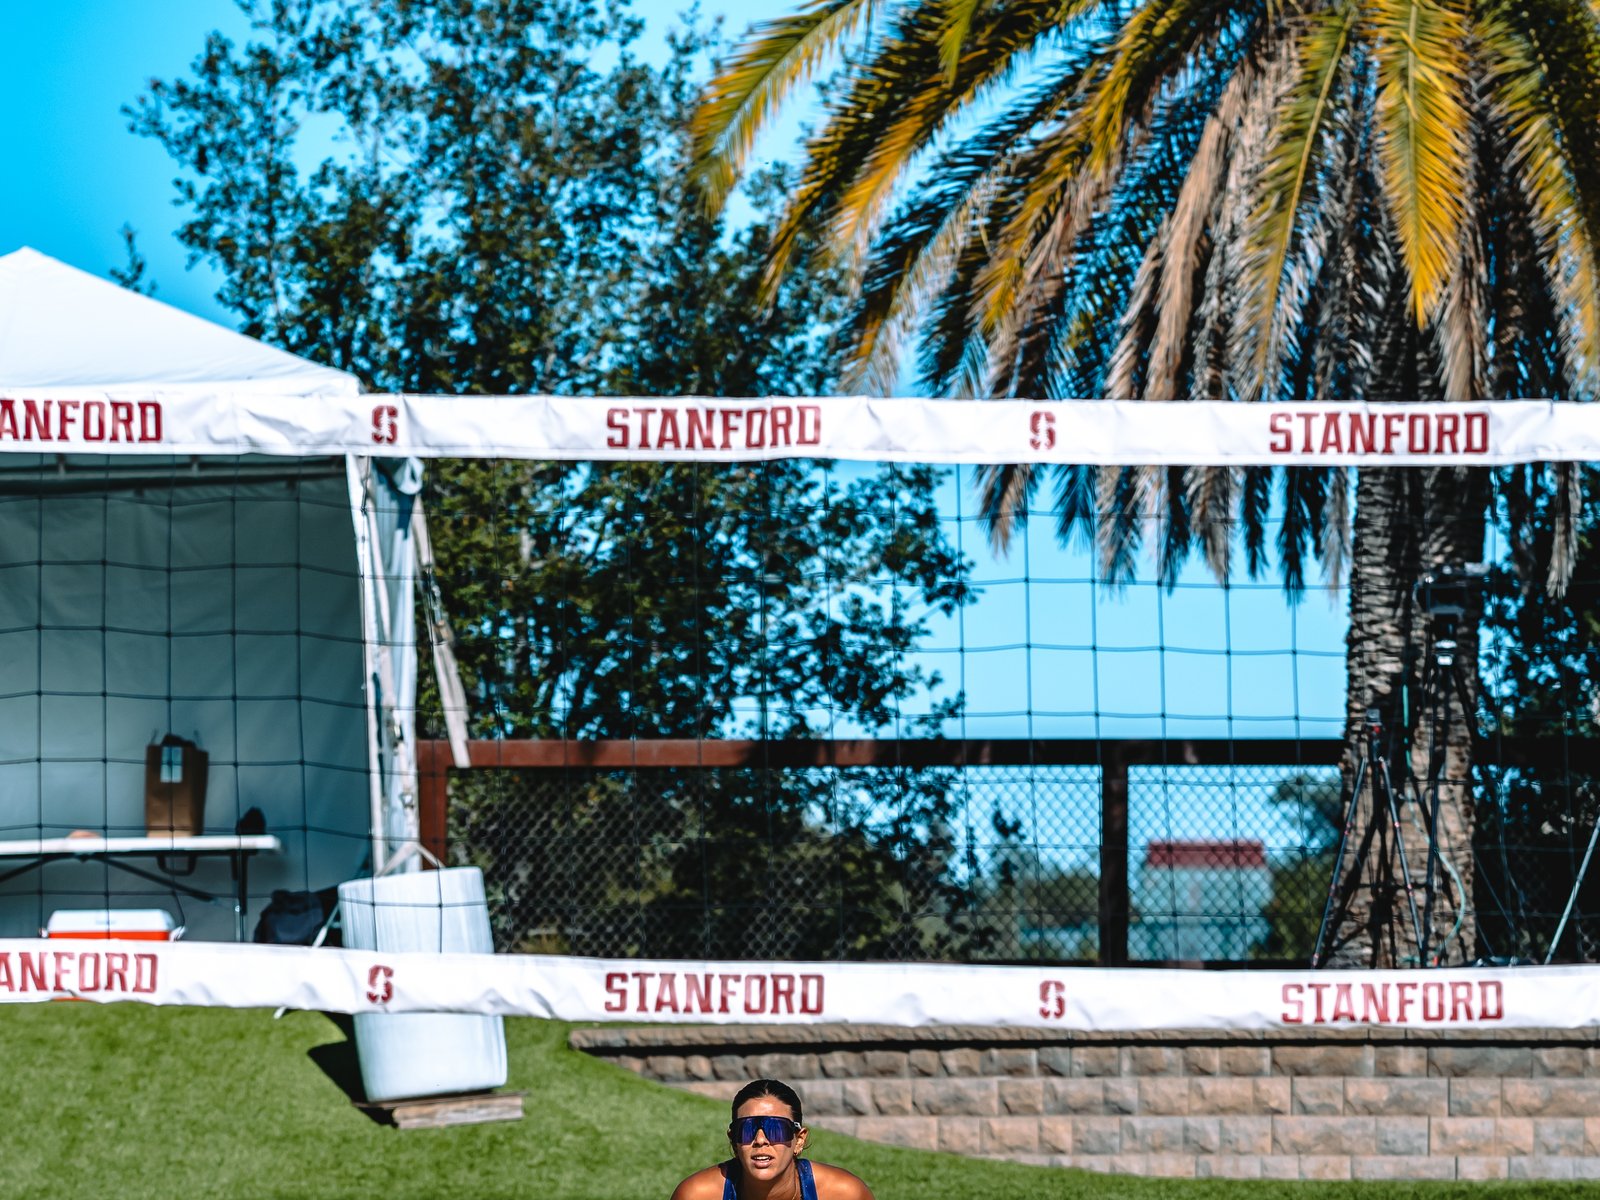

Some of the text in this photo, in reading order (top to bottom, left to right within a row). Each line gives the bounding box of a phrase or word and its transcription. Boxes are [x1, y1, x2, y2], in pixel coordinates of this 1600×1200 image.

[608, 406, 820, 448] STANFORD
[1271, 413, 1487, 453] STANFORD
[606, 973, 823, 1014] STANFORD
[1282, 982, 1502, 1023] STANFORD
